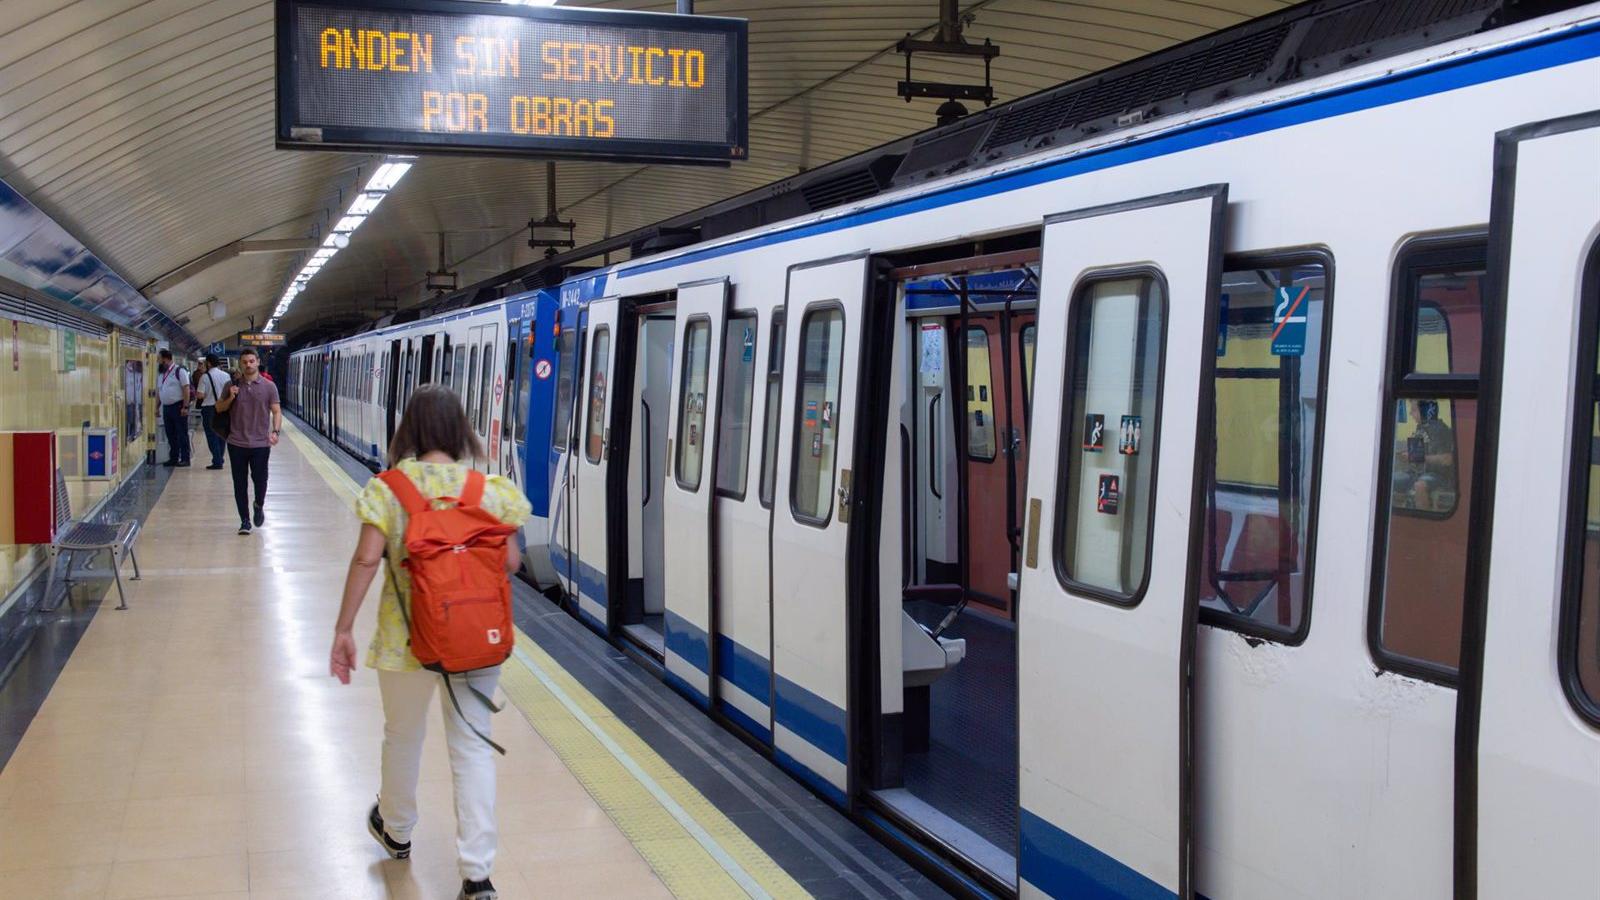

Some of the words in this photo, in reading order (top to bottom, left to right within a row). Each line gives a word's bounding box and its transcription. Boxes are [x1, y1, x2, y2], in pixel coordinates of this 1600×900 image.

[321, 28, 432, 72] ANDEN
[456, 36, 519, 77] SIN
[542, 41, 705, 87] SERVICIO
[423, 91, 488, 132] POR
[511, 96, 614, 137] OBRAS
